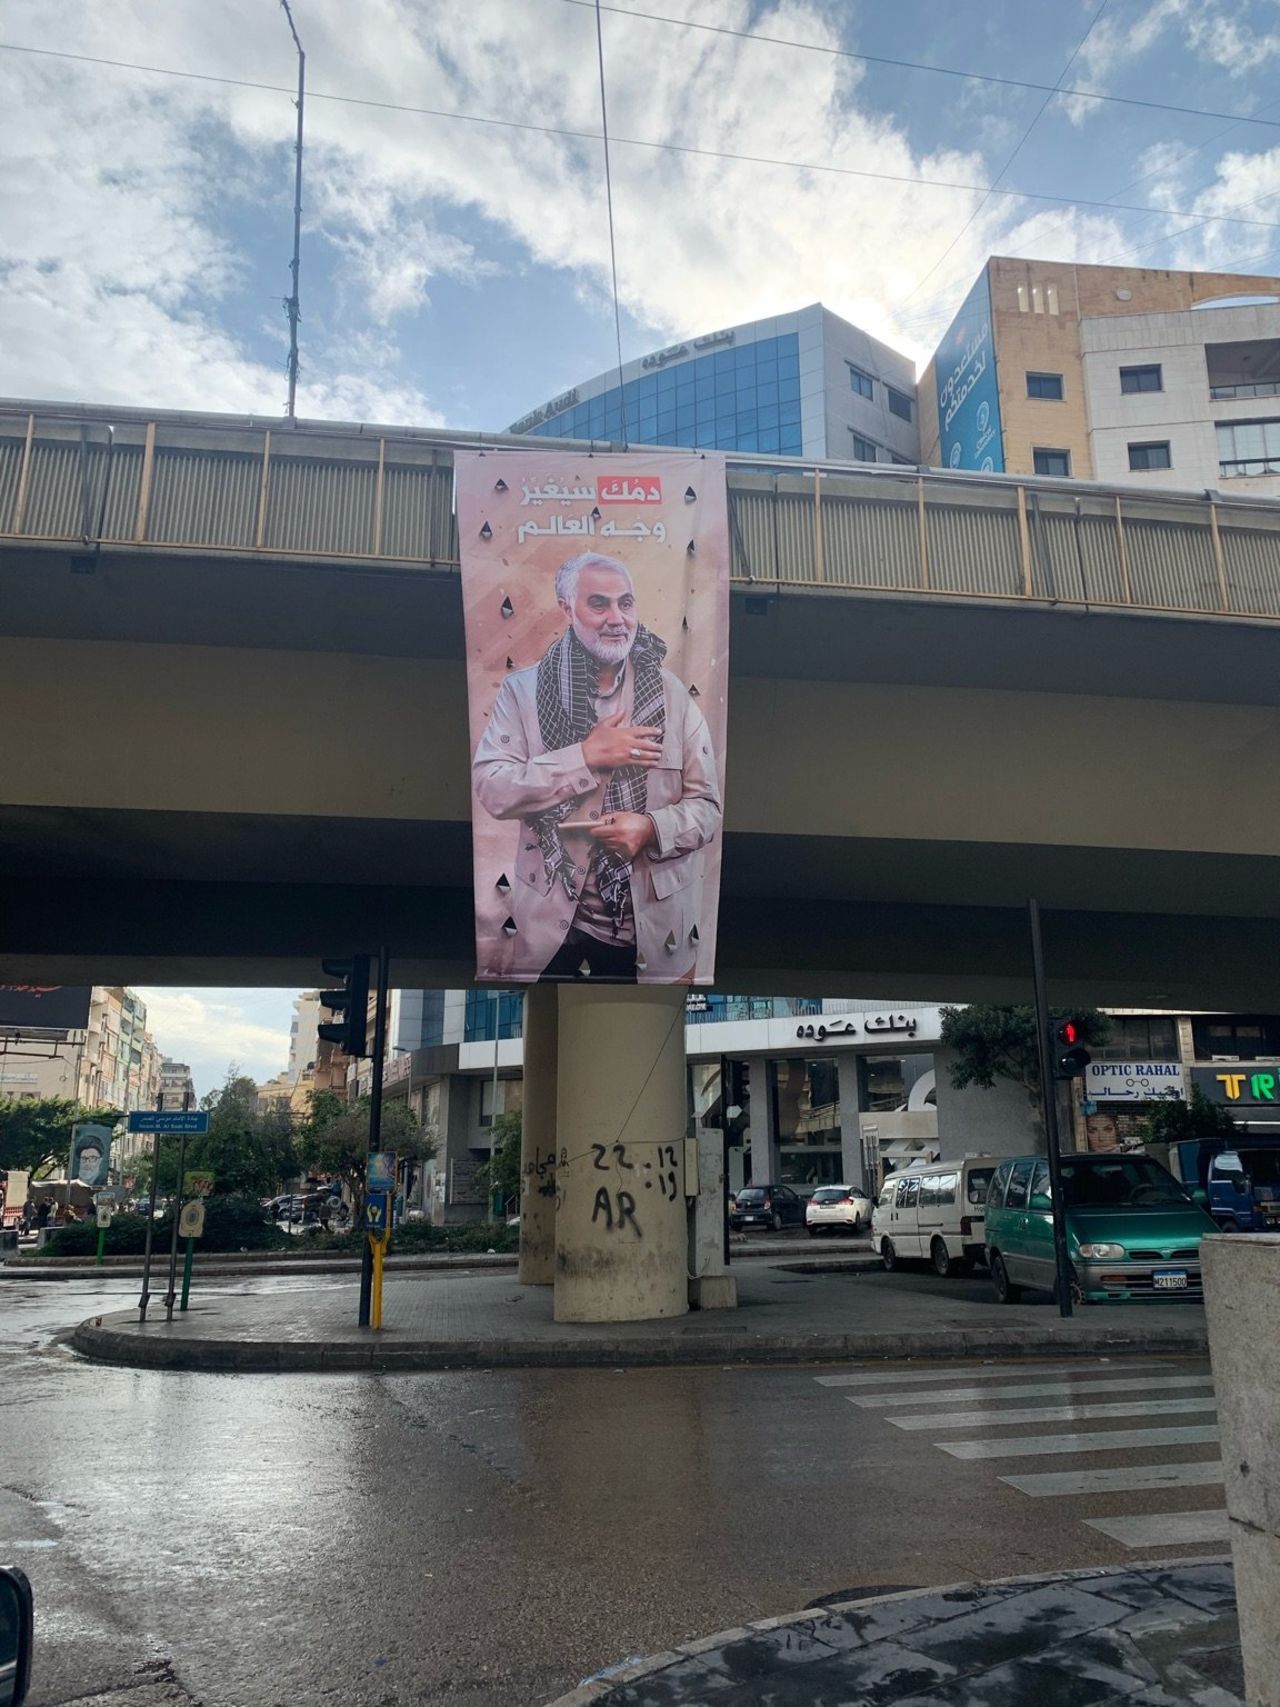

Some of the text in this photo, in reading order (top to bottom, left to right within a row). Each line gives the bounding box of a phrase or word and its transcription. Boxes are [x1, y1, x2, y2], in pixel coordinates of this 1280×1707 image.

[544, 388, 580, 419] Audi
[864, 1014, 917, 1038] بنك
[1091, 1064, 1180, 1077] OPTIC RAHAL
[1215, 1068, 1280, 1100] TR
